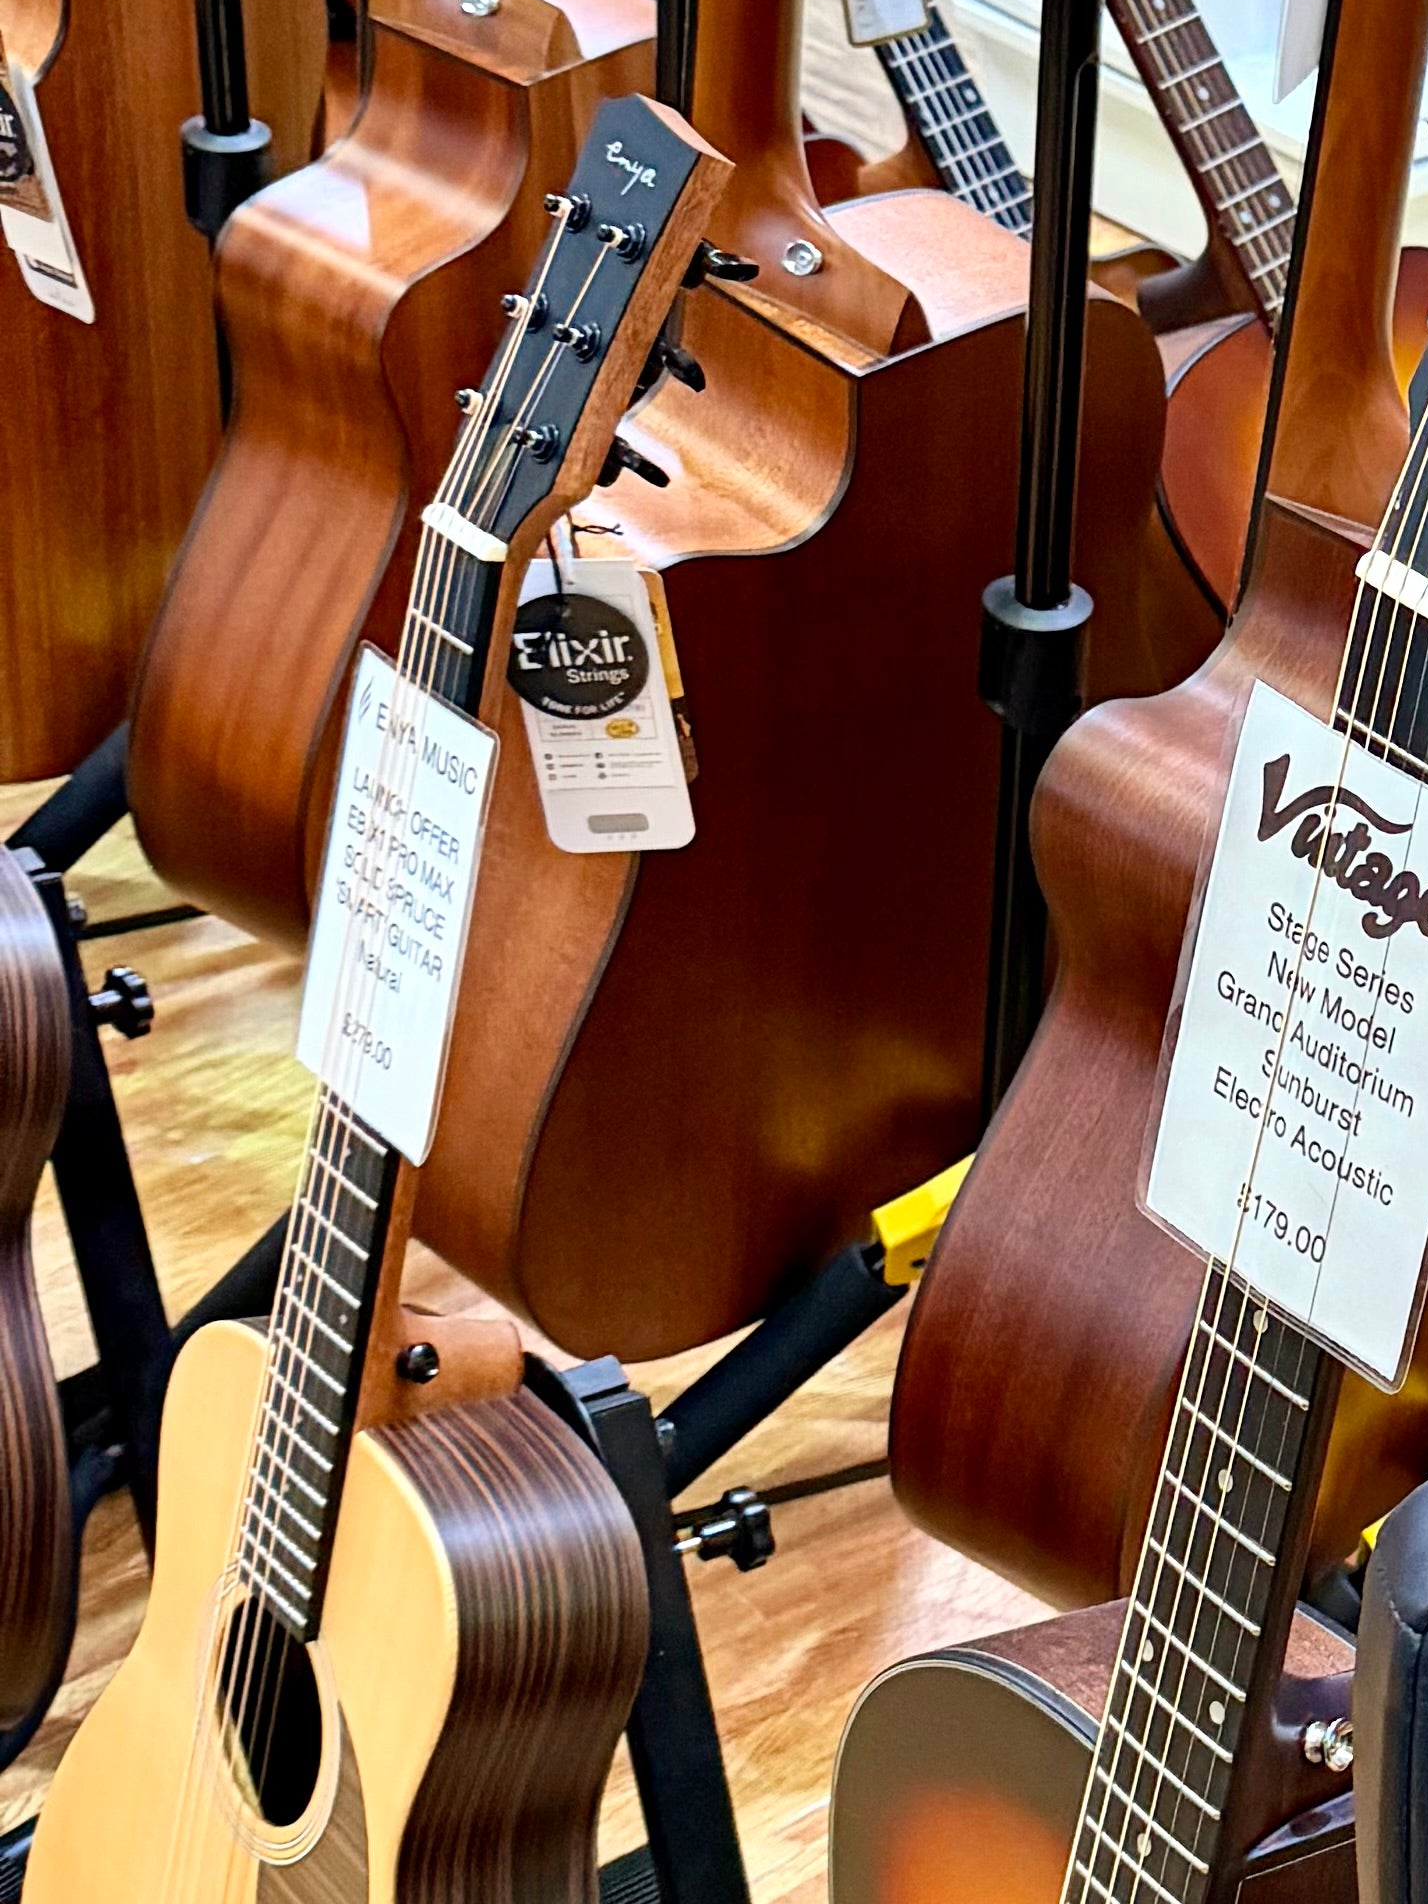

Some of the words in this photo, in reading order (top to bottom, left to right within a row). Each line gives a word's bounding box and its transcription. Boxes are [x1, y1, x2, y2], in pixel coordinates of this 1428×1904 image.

[513, 629, 630, 670] Elixir
[566, 668, 630, 685] Strings
[421, 736, 478, 796] MUSIC
[410, 810, 461, 864] OFFER
[386, 875, 447, 942] SPRUCE
[420, 859, 456, 904] MAX
[388, 922, 444, 983] GUITAR
[1266, 901, 1330, 967] Stage
[1334, 945, 1416, 1016] Series
[1266, 950, 1317, 1008] New
[1320, 990, 1397, 1056] Model
[1261, 1045, 1365, 1139] Sunburst
[1290, 1019, 1416, 1119] Auditorium
[1290, 1122, 1396, 1208] Acoustic
